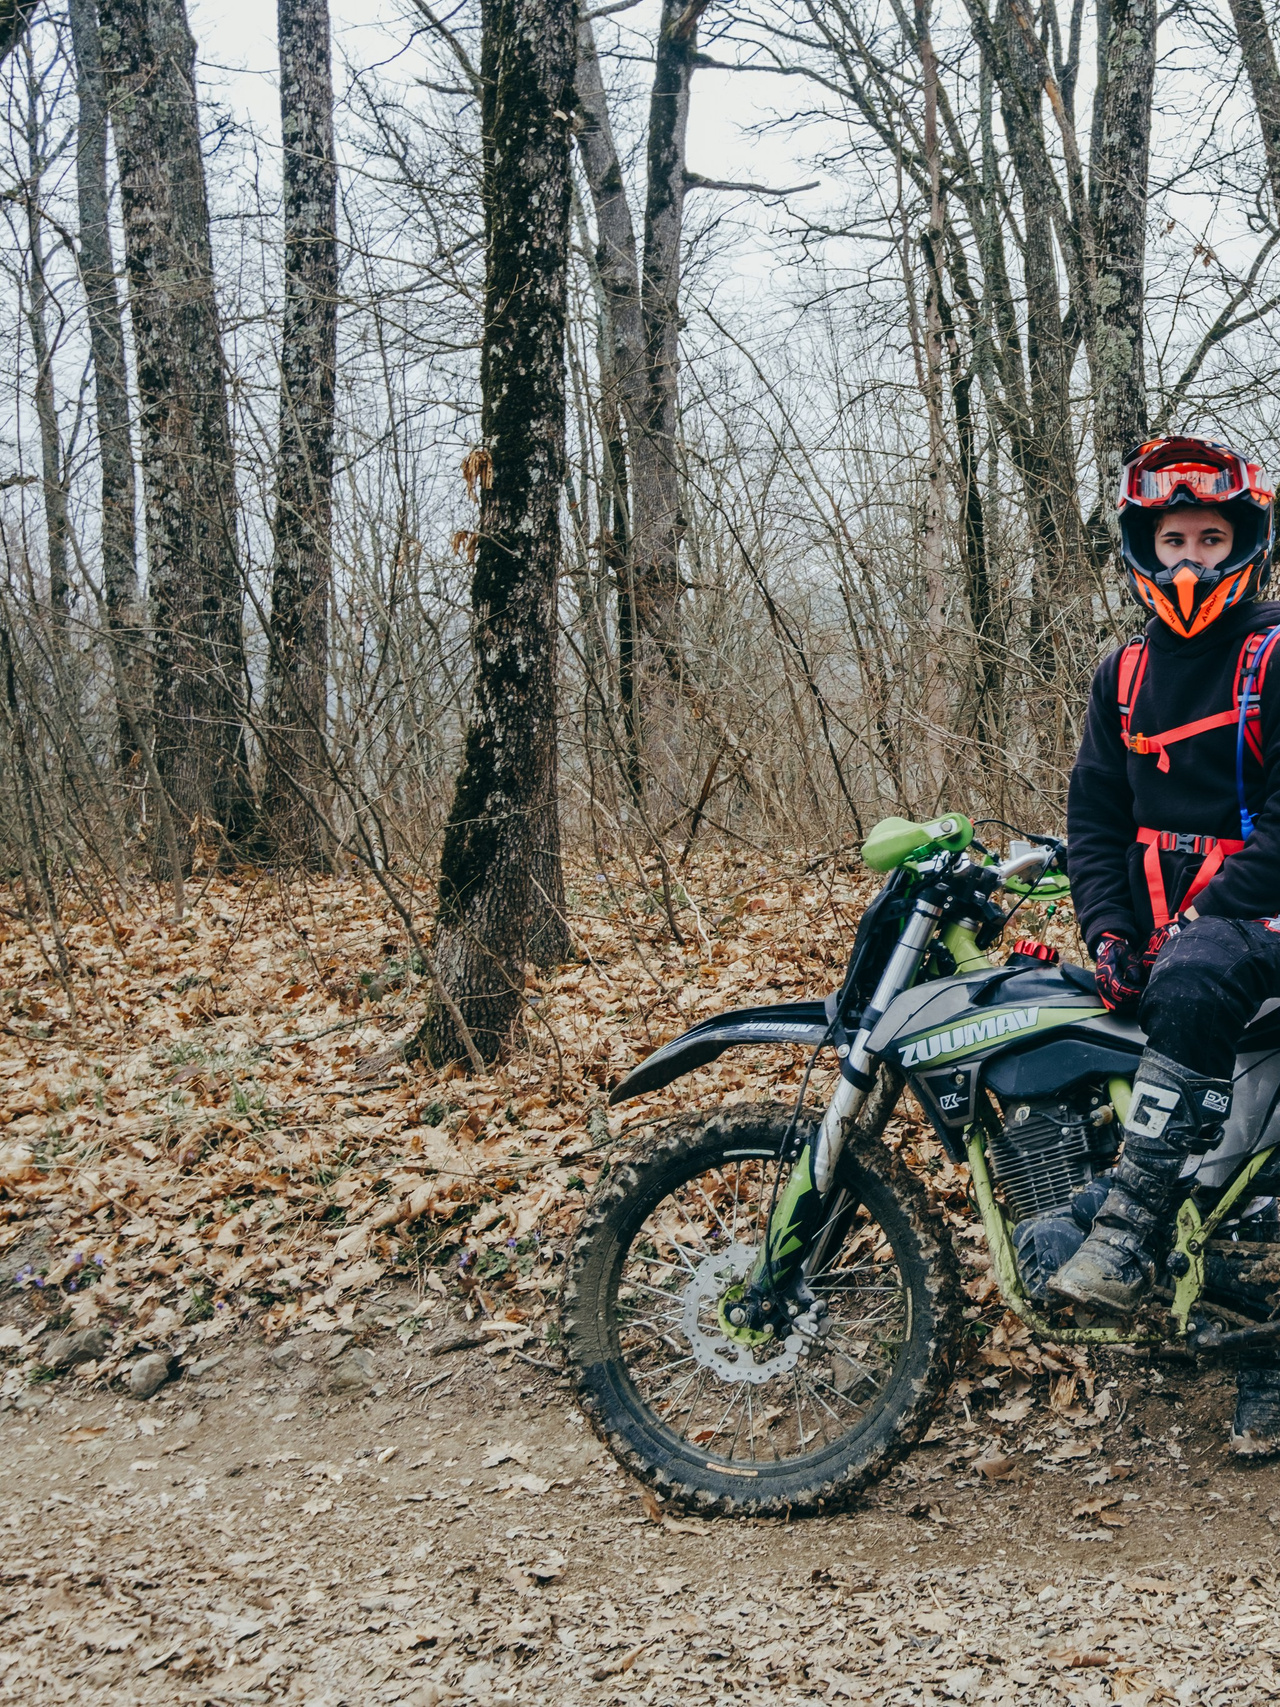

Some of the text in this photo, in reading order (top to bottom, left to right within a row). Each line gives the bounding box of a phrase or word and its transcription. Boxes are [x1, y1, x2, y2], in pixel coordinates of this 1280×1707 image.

[738, 1022, 816, 1033] ZUUMAV
[898, 1006, 1040, 1068] ZUUMAV
[1124, 1080, 1181, 1139] G
